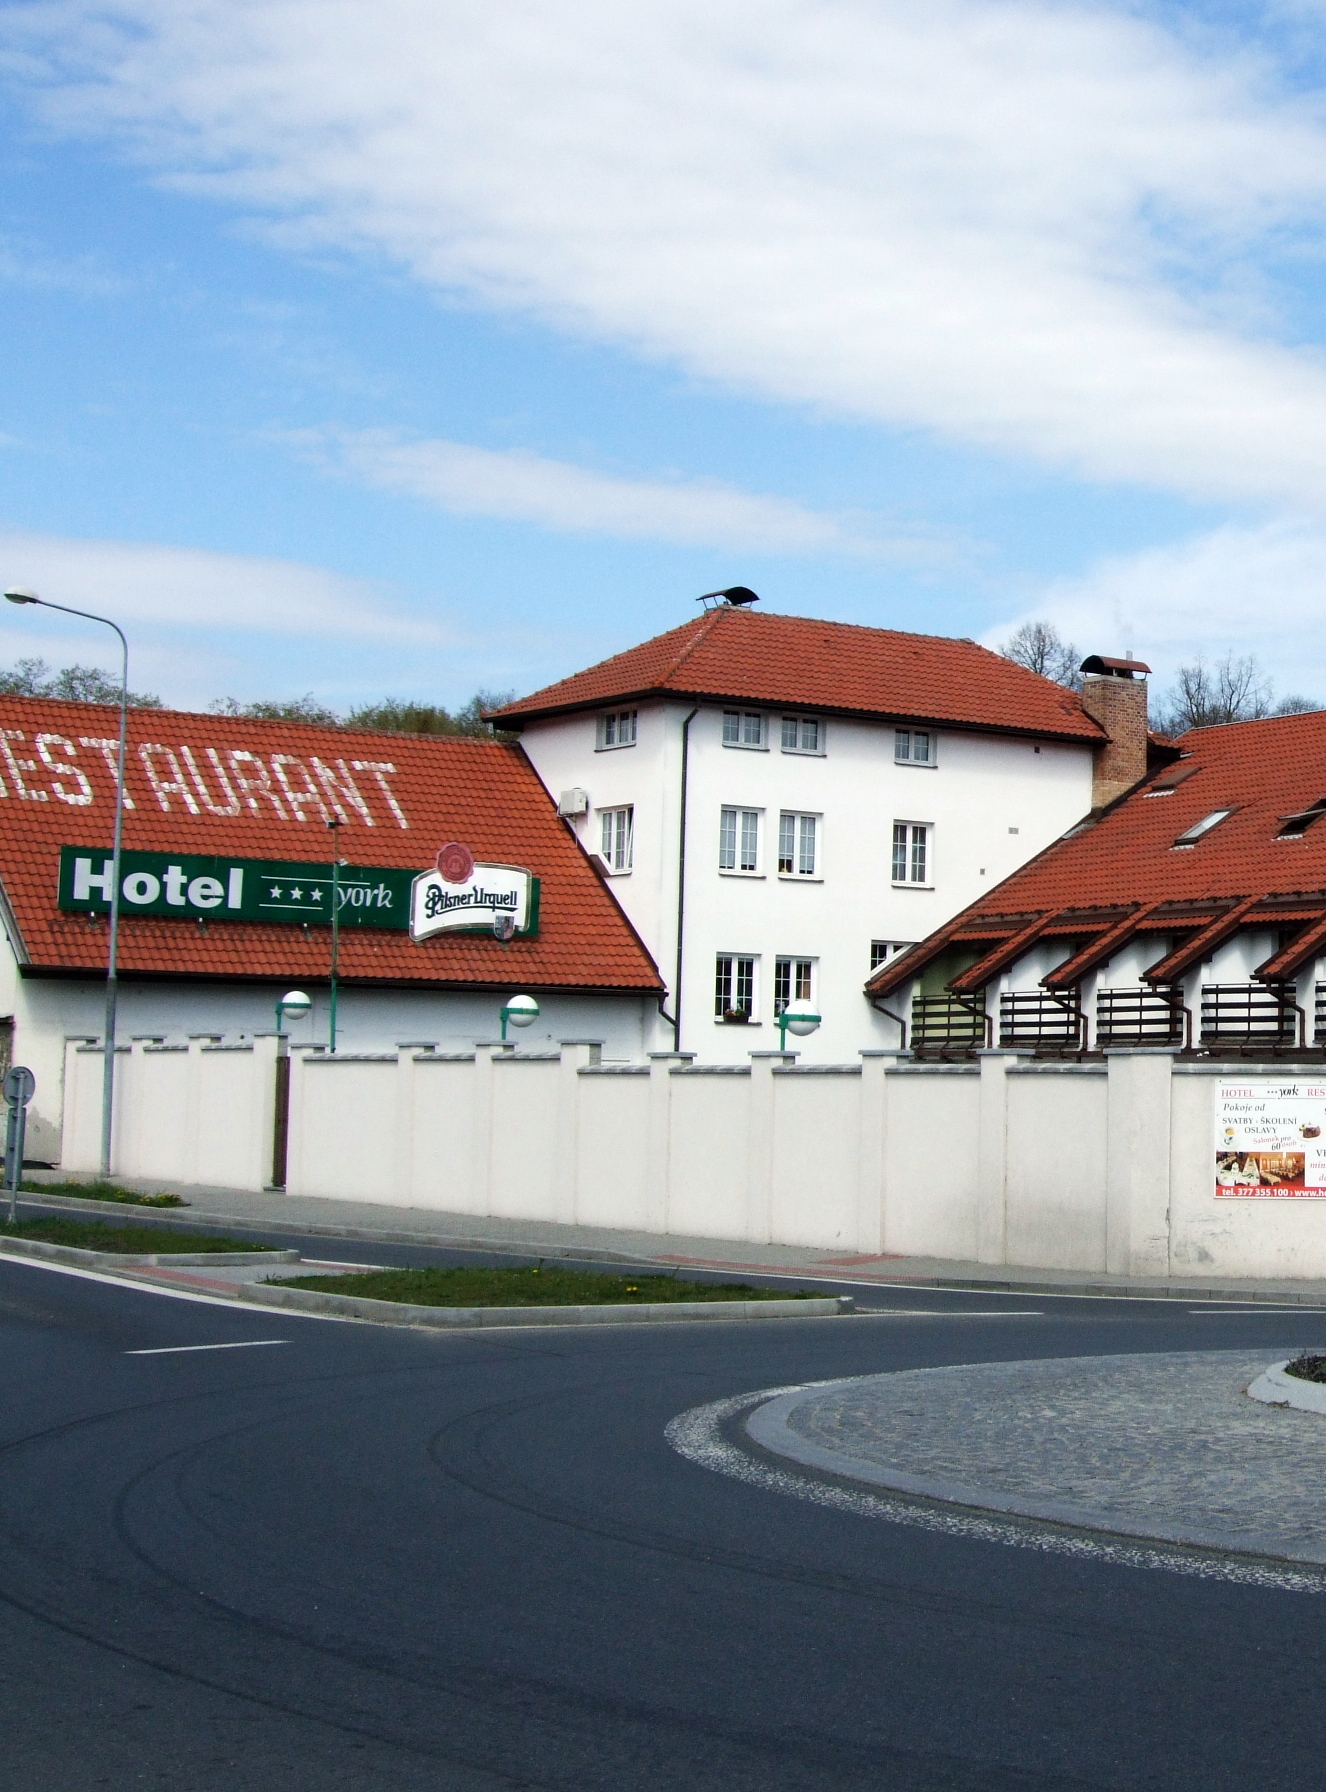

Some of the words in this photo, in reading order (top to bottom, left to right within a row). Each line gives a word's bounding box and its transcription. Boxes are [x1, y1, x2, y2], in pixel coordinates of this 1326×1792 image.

[0, 727, 410, 830] ESTAURANT
[73, 857, 244, 910] Hotel
[335, 882, 394, 912] york
[424, 883, 475, 919] Pilsner
[472, 885, 518, 912] Urquell
[1221, 1089, 1255, 1097] HOTEL
[1277, 1084, 1299, 1100] york
[1223, 1103, 1253, 1114] Pokoje
[1254, 1103, 1266, 1112] od
[1222, 1117, 1254, 1125] SVATBY
[1260, 1116, 1297, 1125] ŠKOLENÍ
[1244, 1126, 1278, 1134] OSLAVY
[1222, 1188, 1236, 1196] tel.
[1238, 1188, 1254, 1196] 377
[1255, 1188, 1271, 1197] 355
[1273, 1188, 1289, 1197] 100
